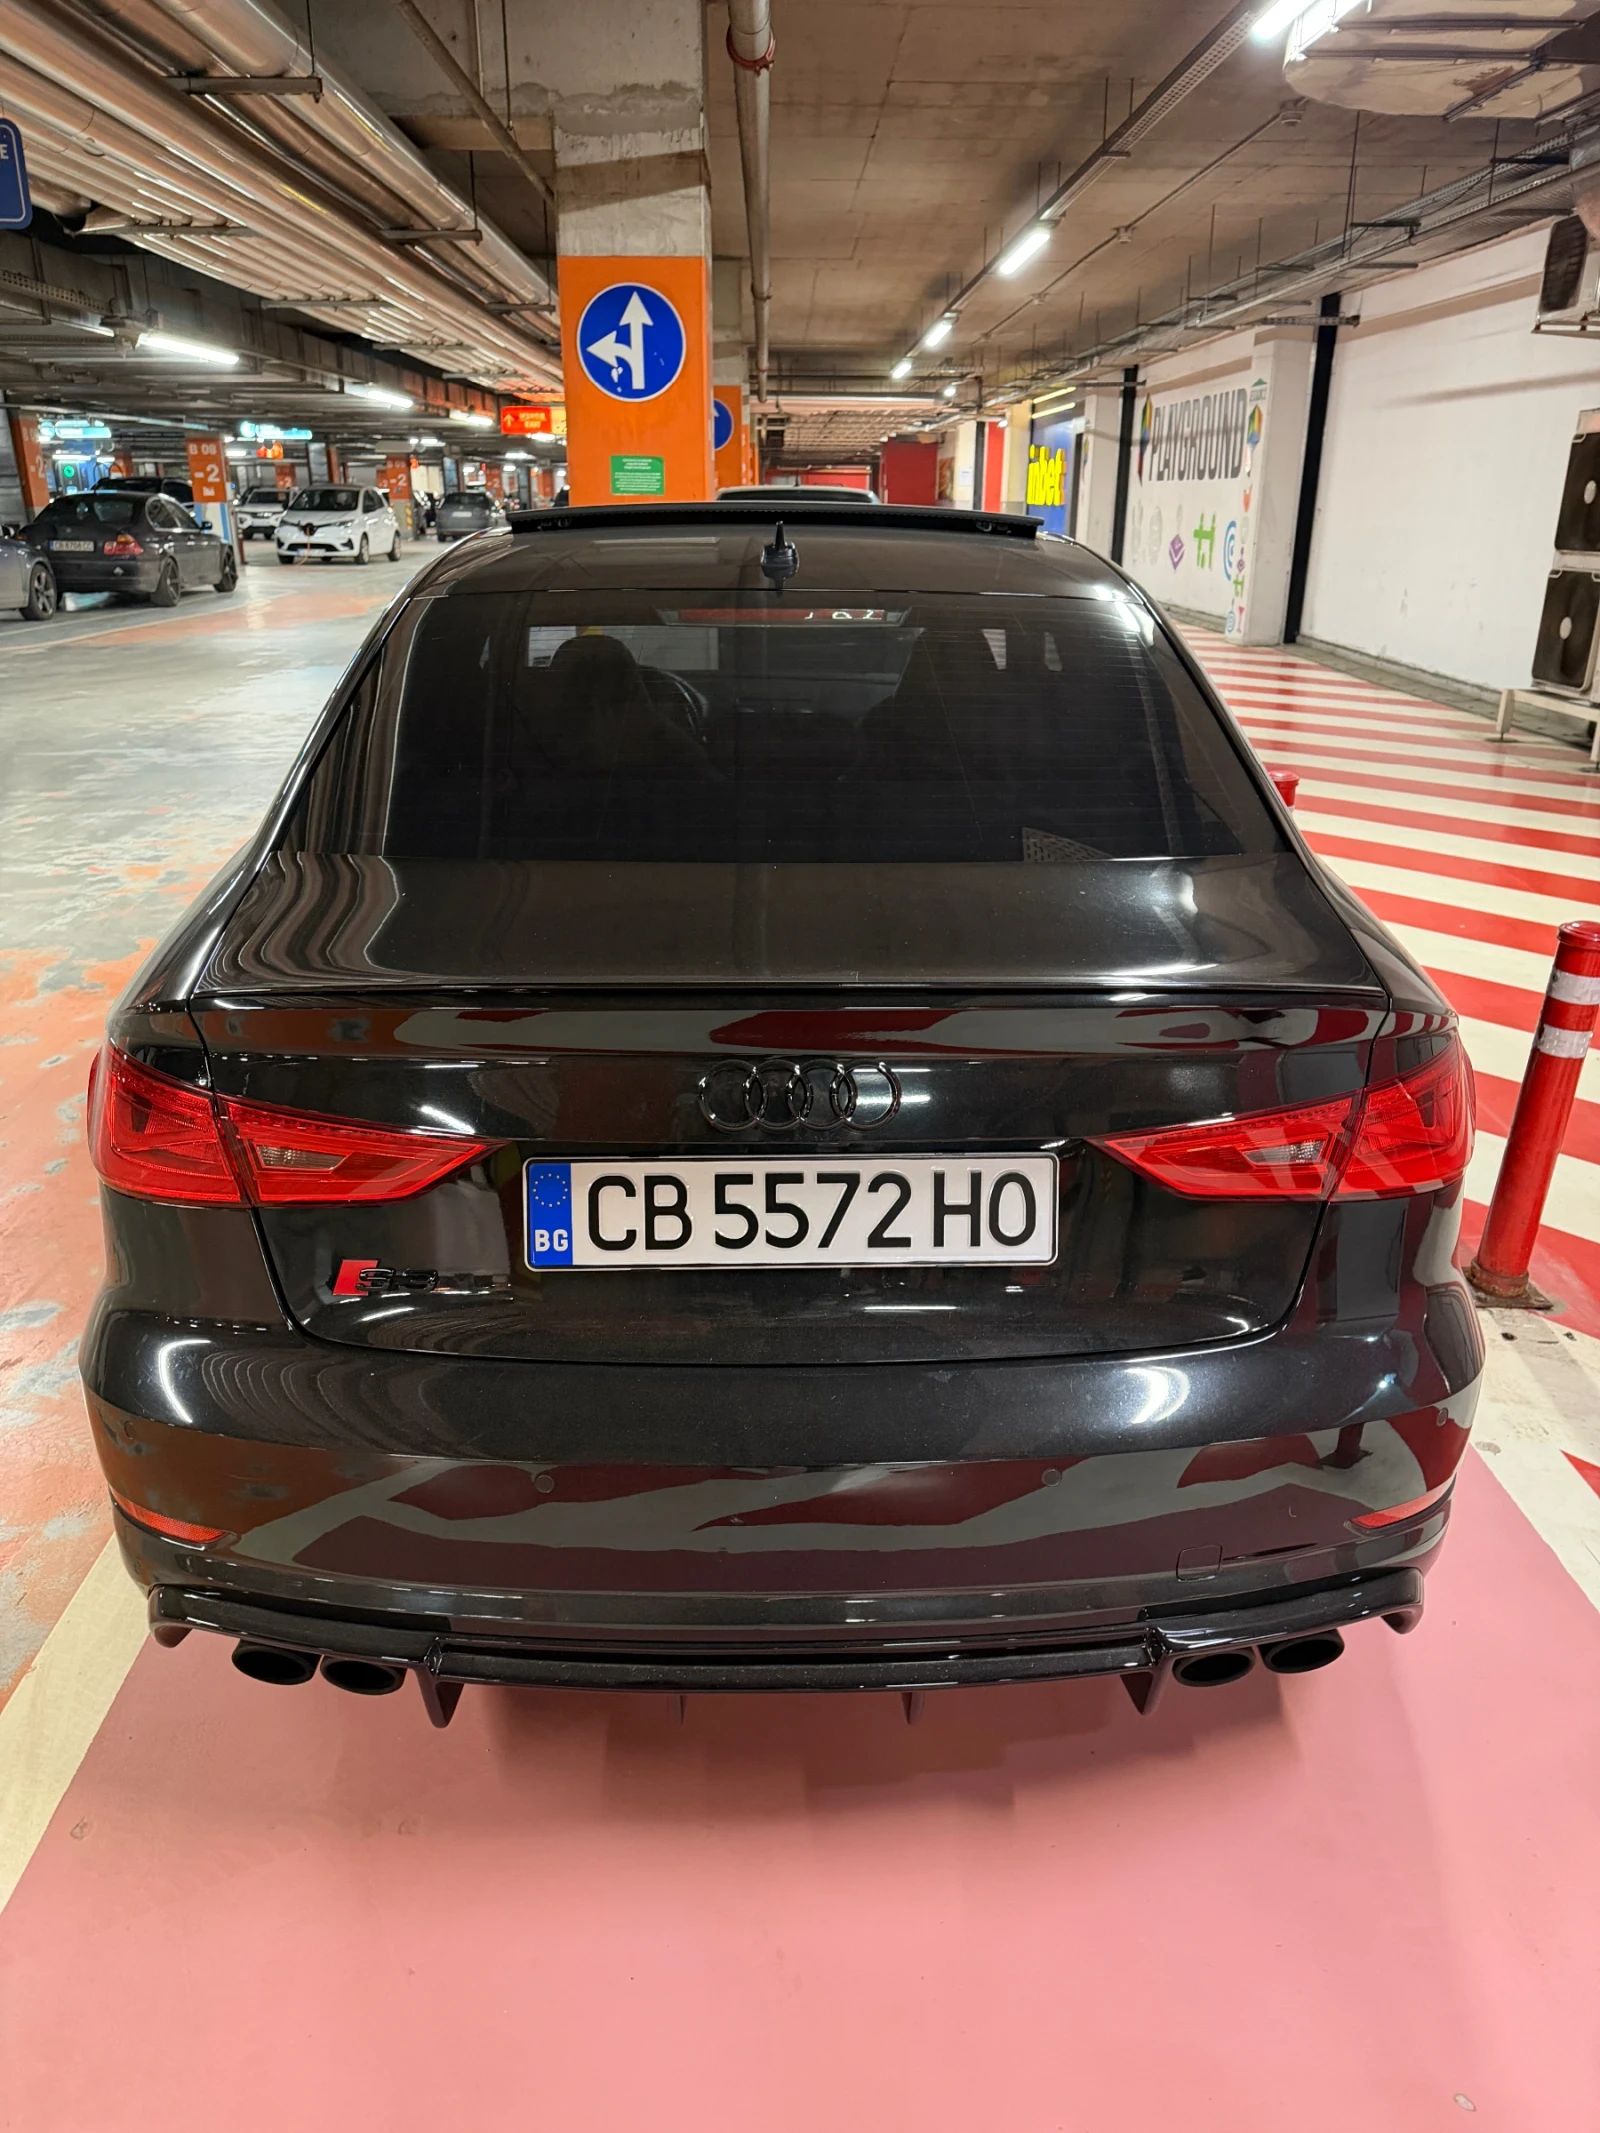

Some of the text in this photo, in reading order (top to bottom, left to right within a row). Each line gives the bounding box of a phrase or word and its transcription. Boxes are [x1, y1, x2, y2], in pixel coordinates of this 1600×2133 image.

[189, 443, 198, 455] B
[1149, 388, 1247, 482] PLAYGROUND
[194, 464, 221, 483] -2
[1026, 444, 1064, 506] inbet
[588, 1171, 1037, 1251] CB 5572 HO
[534, 1228, 569, 1252] BG
